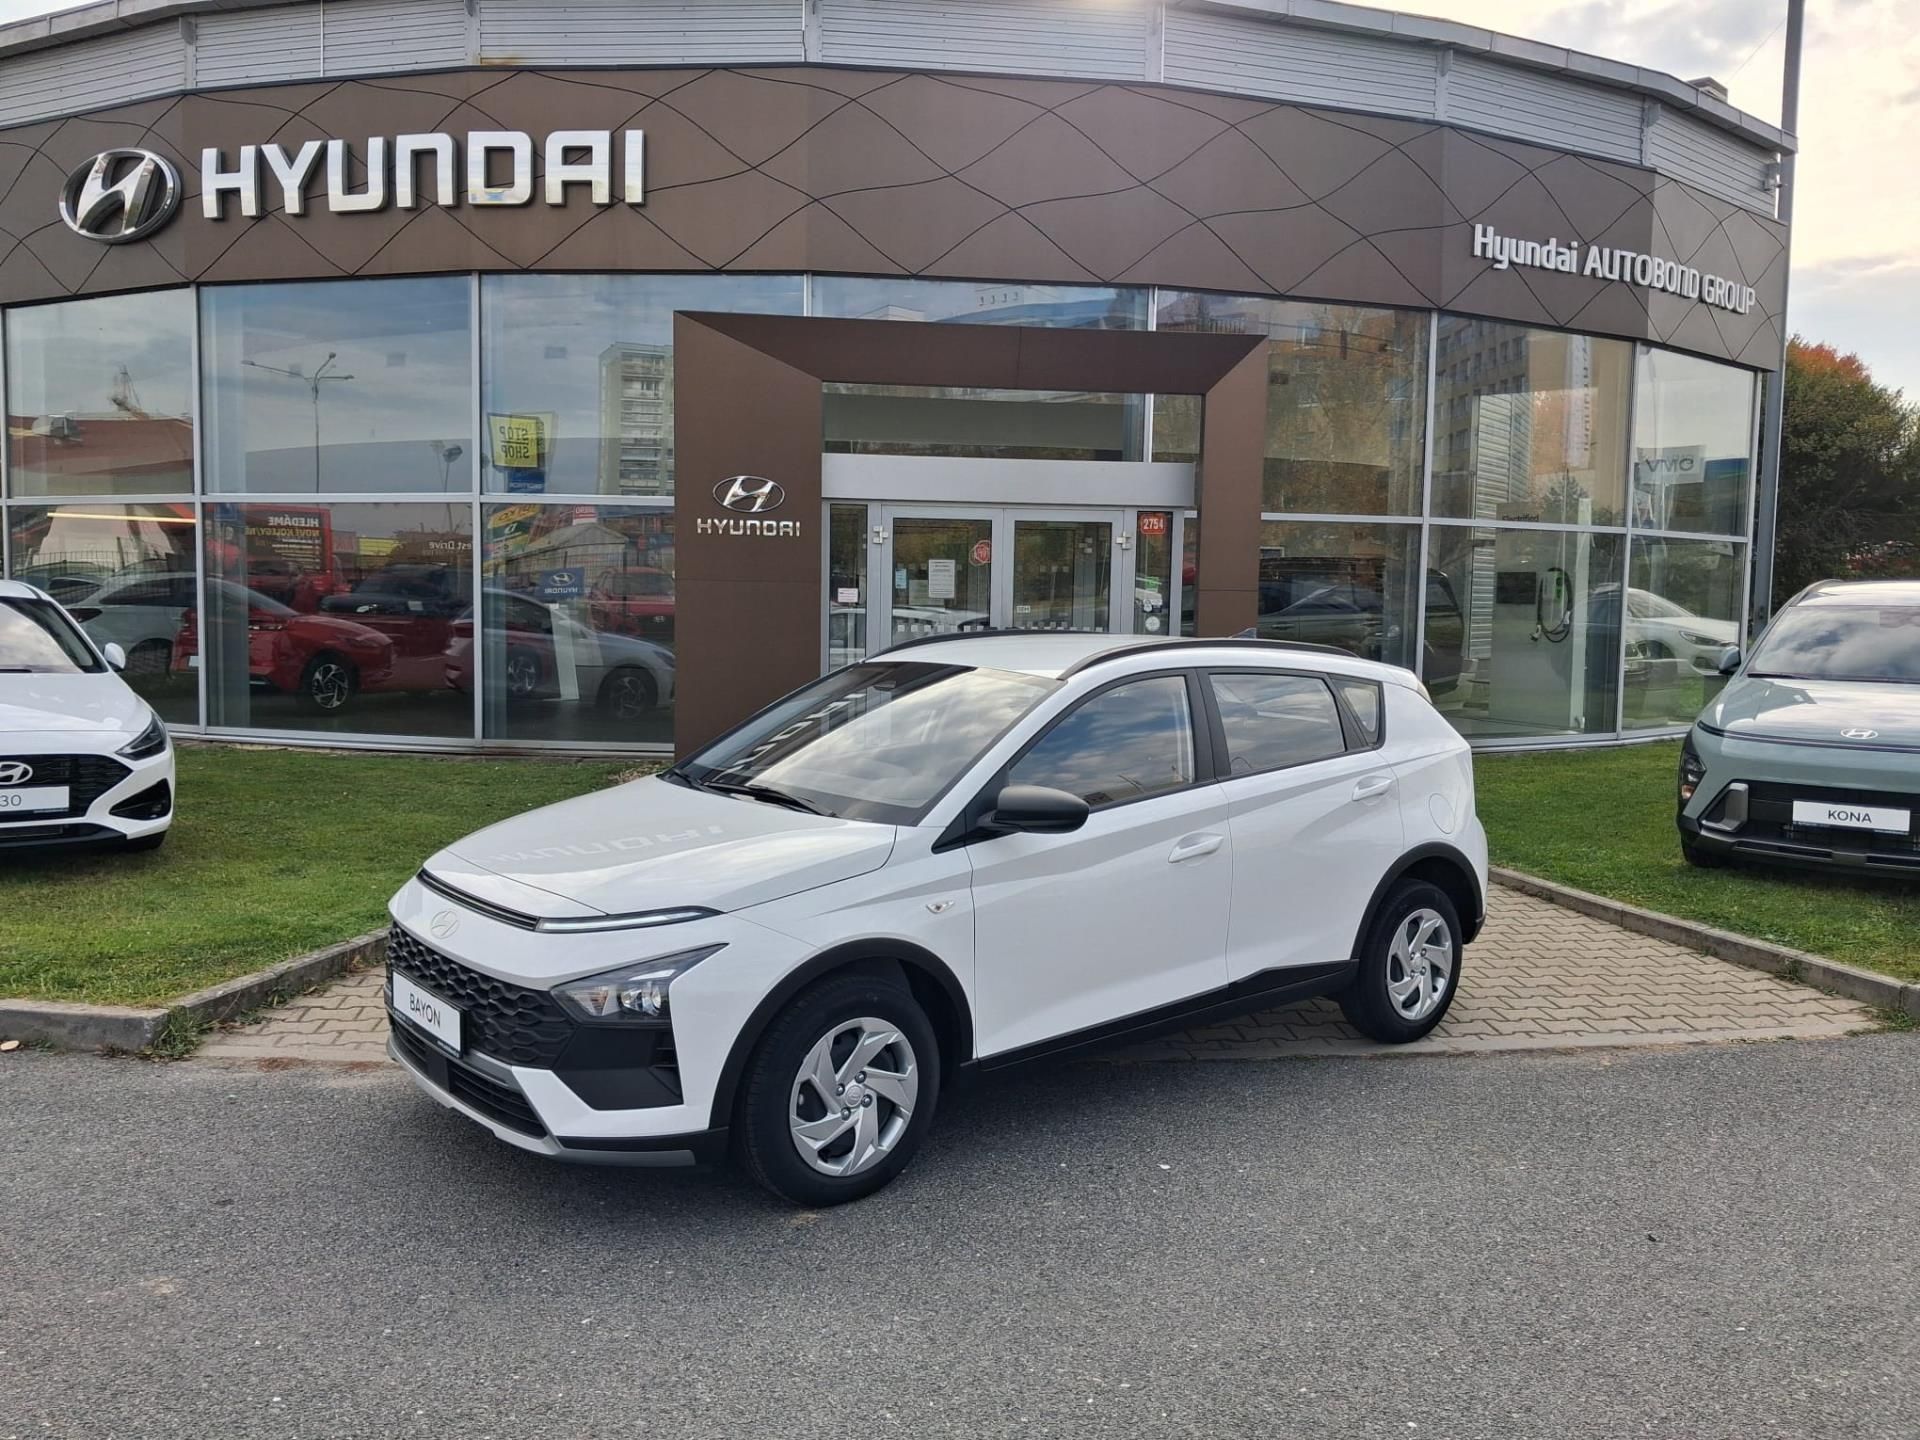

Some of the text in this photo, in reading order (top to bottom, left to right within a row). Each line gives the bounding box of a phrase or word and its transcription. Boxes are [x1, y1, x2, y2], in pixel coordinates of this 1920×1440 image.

[201, 129, 646, 220] HYUNDAI
[1474, 223, 1757, 315] Hyundai AUTOBOND GROUP
[697, 518, 800, 537] HYUNDAI
[1143, 518, 1164, 530] 2754
[0, 794, 22, 808] 30
[1828, 810, 1872, 823] KONA
[409, 992, 441, 1029] BAYON
